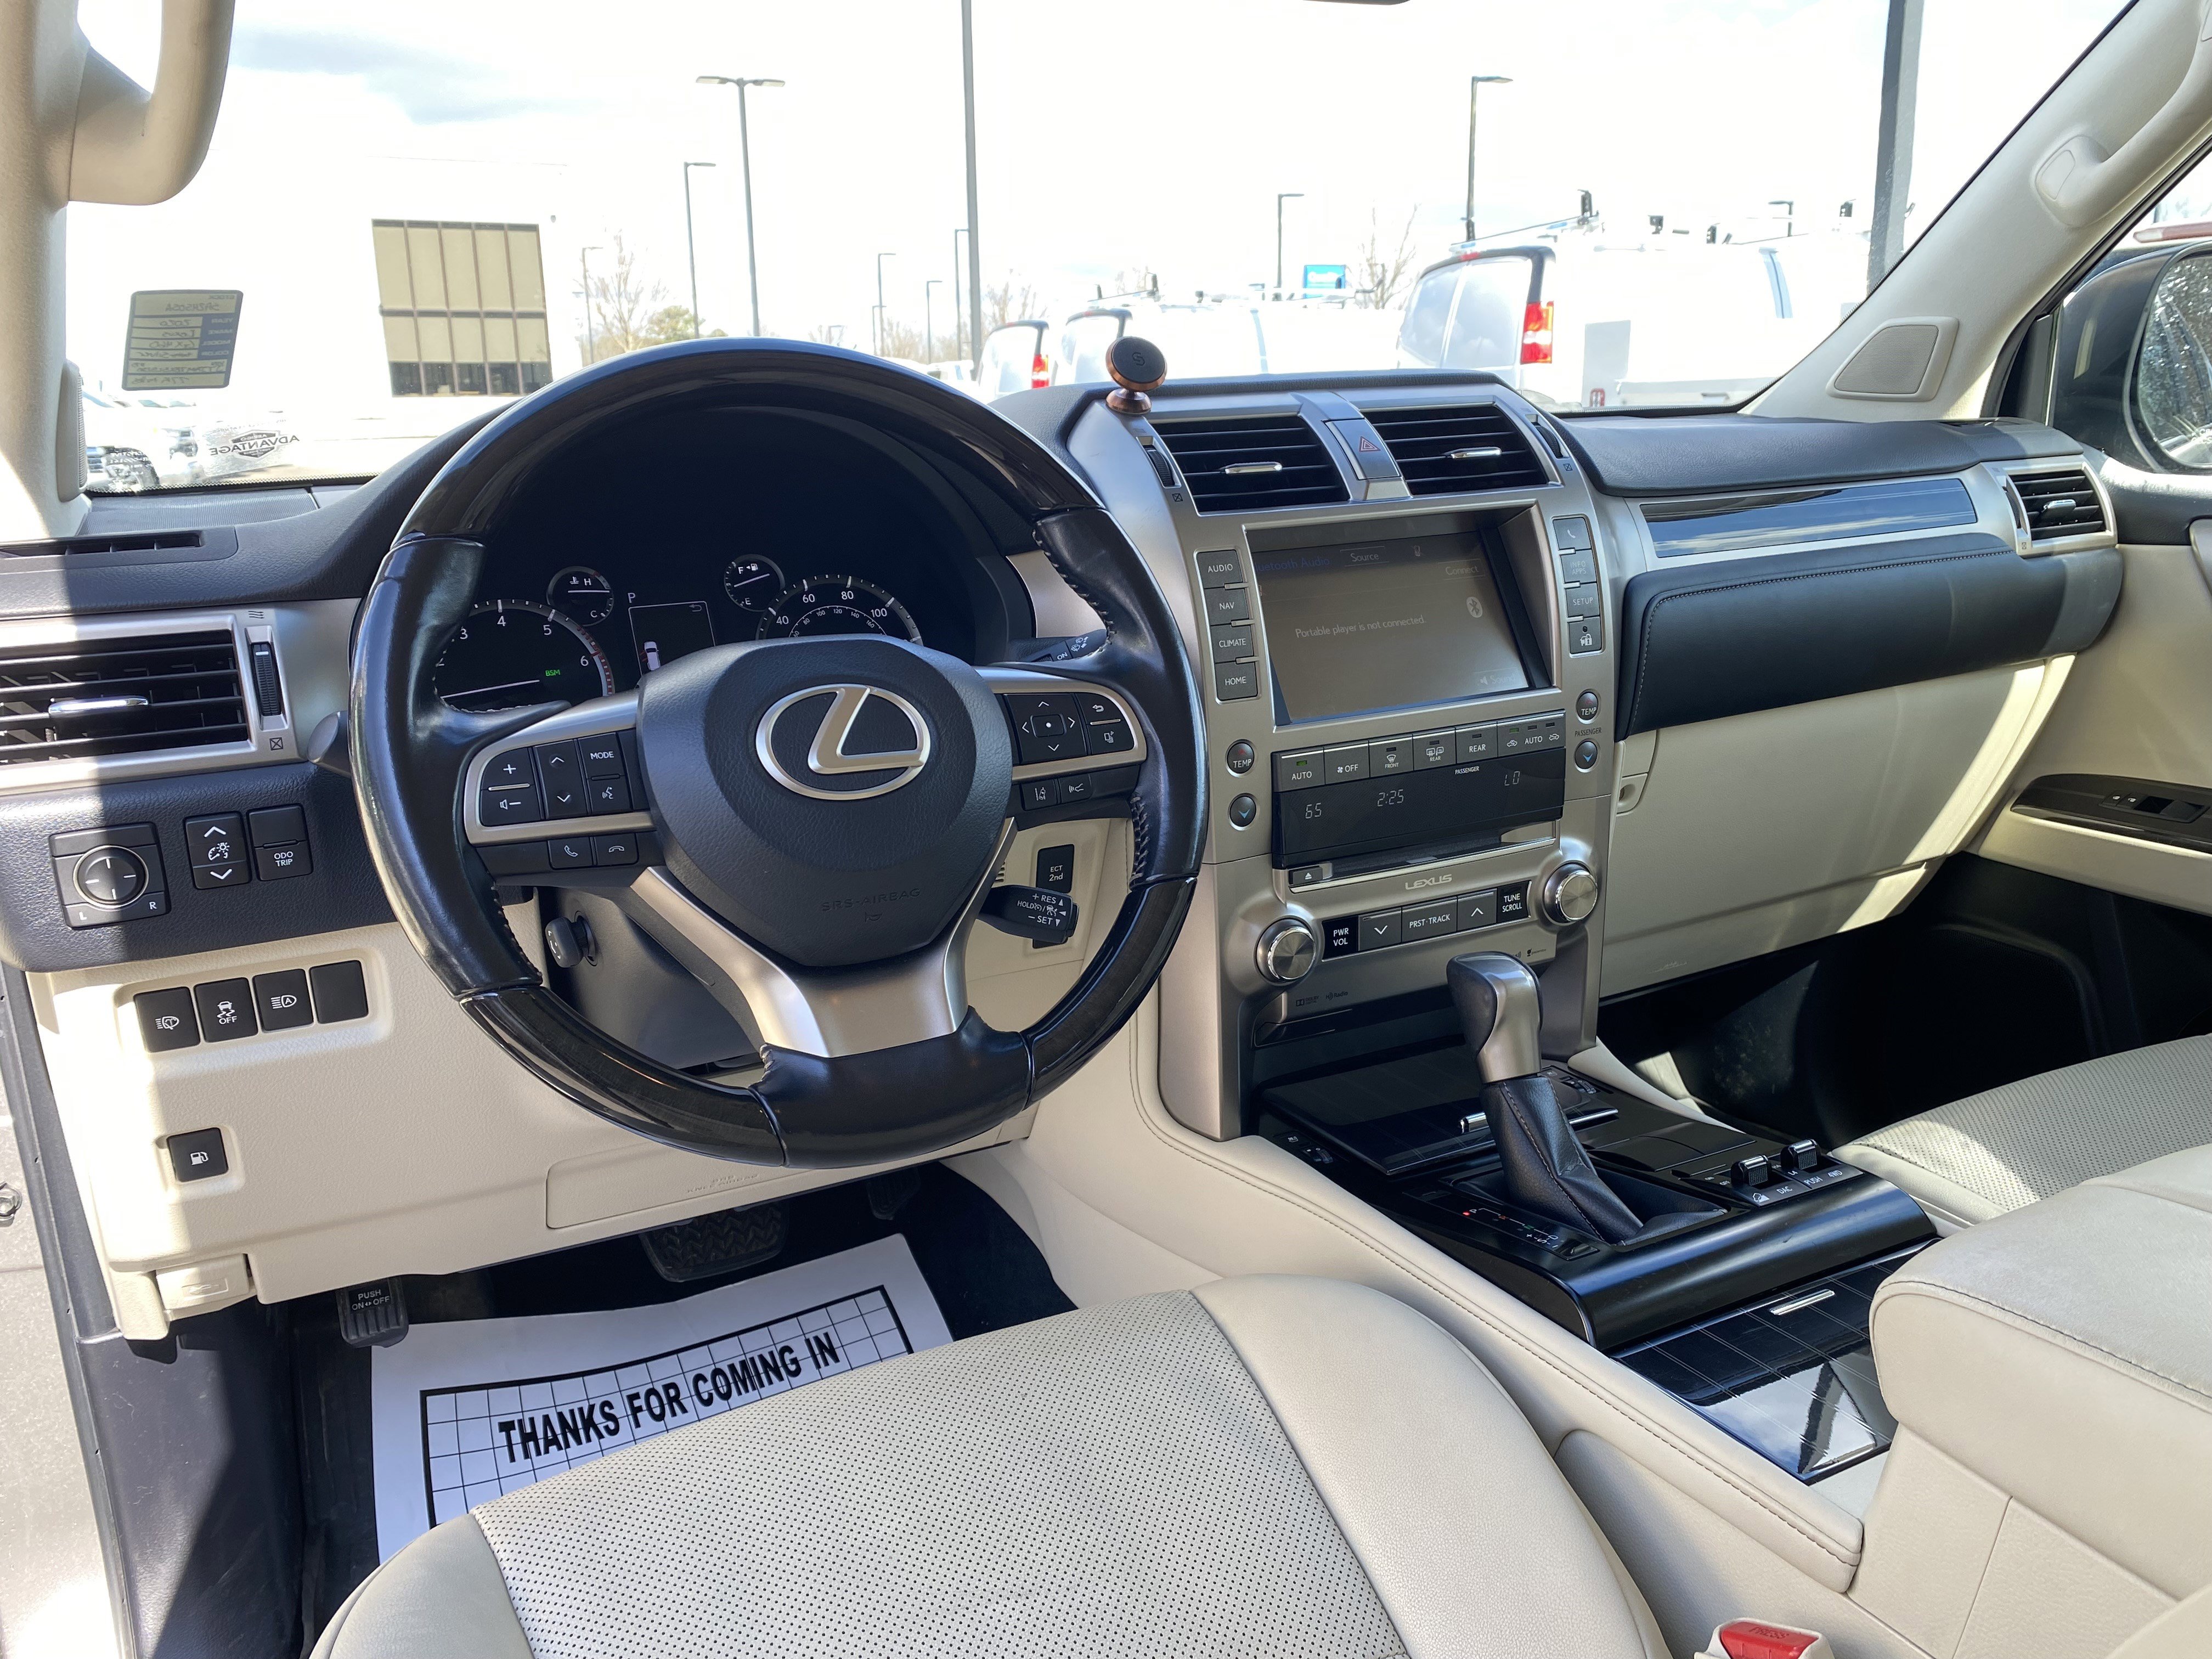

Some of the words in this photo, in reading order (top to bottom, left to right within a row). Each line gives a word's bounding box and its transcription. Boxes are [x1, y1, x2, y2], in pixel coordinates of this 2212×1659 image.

[1350, 552, 1379, 562] Source
[1207, 563, 1233, 573] AUDIO
[1254, 560, 1297, 572] luetooth
[1301, 556, 1330, 567] Audio
[1446, 566, 1479, 575] Connect
[584, 578, 591, 586] H
[627, 592, 636, 603] P
[802, 594, 815, 603] 60
[841, 591, 854, 600] 80
[1219, 602, 1234, 610] NAV
[1573, 597, 1593, 606] SETUP
[850, 611, 860, 619] 140
[871, 608, 887, 618] 100
[497, 616, 506, 627] 4
[776, 616, 789, 625] 40
[865, 620, 875, 629] 160
[543, 625, 552, 635] 5
[1295, 626, 1330, 638] Portable
[1333, 624, 1357, 636] player
[1359, 622, 1365, 630] is
[1367, 621, 1381, 629] not
[1383, 614, 1426, 628] connected.
[460, 628, 468, 640] 3
[1218, 638, 1246, 648] CLIMATE
[580, 656, 589, 666] 6
[1057, 652, 1068, 660] ON
[1224, 676, 1246, 686] HOME
[1491, 674, 1517, 684] Sound
[1581, 707, 1596, 716] TEMP
[1575, 727, 1602, 737] PASSENGER
[1525, 736, 1543, 744] AUTO
[1469, 744, 1486, 753] REAR
[590, 751, 614, 760] MODE
[1233, 758, 1252, 769] TEMP
[1345, 764, 1358, 772] OFF
[1455, 766, 1480, 775] PASSENGER
[1291, 771, 1312, 781] AUTO
[1377, 789, 1404, 807] 2:25
[1305, 803, 1322, 819] 65
[274, 851, 294, 861] ODO
[275, 857, 294, 867] TRIP
[1049, 873, 1063, 882] 2nd
[1405, 874, 1452, 890] LEXUS
[822, 888, 921, 911] SRS-AIRBAG
[1041, 895, 1057, 904] RES
[1503, 893, 1521, 902] TUNE
[149, 901, 157, 910] R
[1017, 900, 1034, 909] HOLD
[1502, 903, 1522, 913] SCROLL
[79, 911, 87, 921] L
[1037, 916, 1053, 925] SET
[1409, 919, 1425, 929] PRST
[1429, 913, 1451, 924] TRACK
[1333, 928, 1349, 937] PWR
[1333, 938, 1348, 946] VOL
[218, 1015, 238, 1025] OFF
[1803, 1176, 1823, 1186] PUSH
[1827, 1170, 1843, 1178] 4WD
[358, 1289, 381, 1300] PUSH
[352, 1302, 364, 1310] ON
[373, 1296, 390, 1305] OFF
[498, 1400, 620, 1463] THANKS
[625, 1382, 689, 1429] FOR
[692, 1345, 801, 1408] COMING
[804, 1331, 840, 1370] IN
